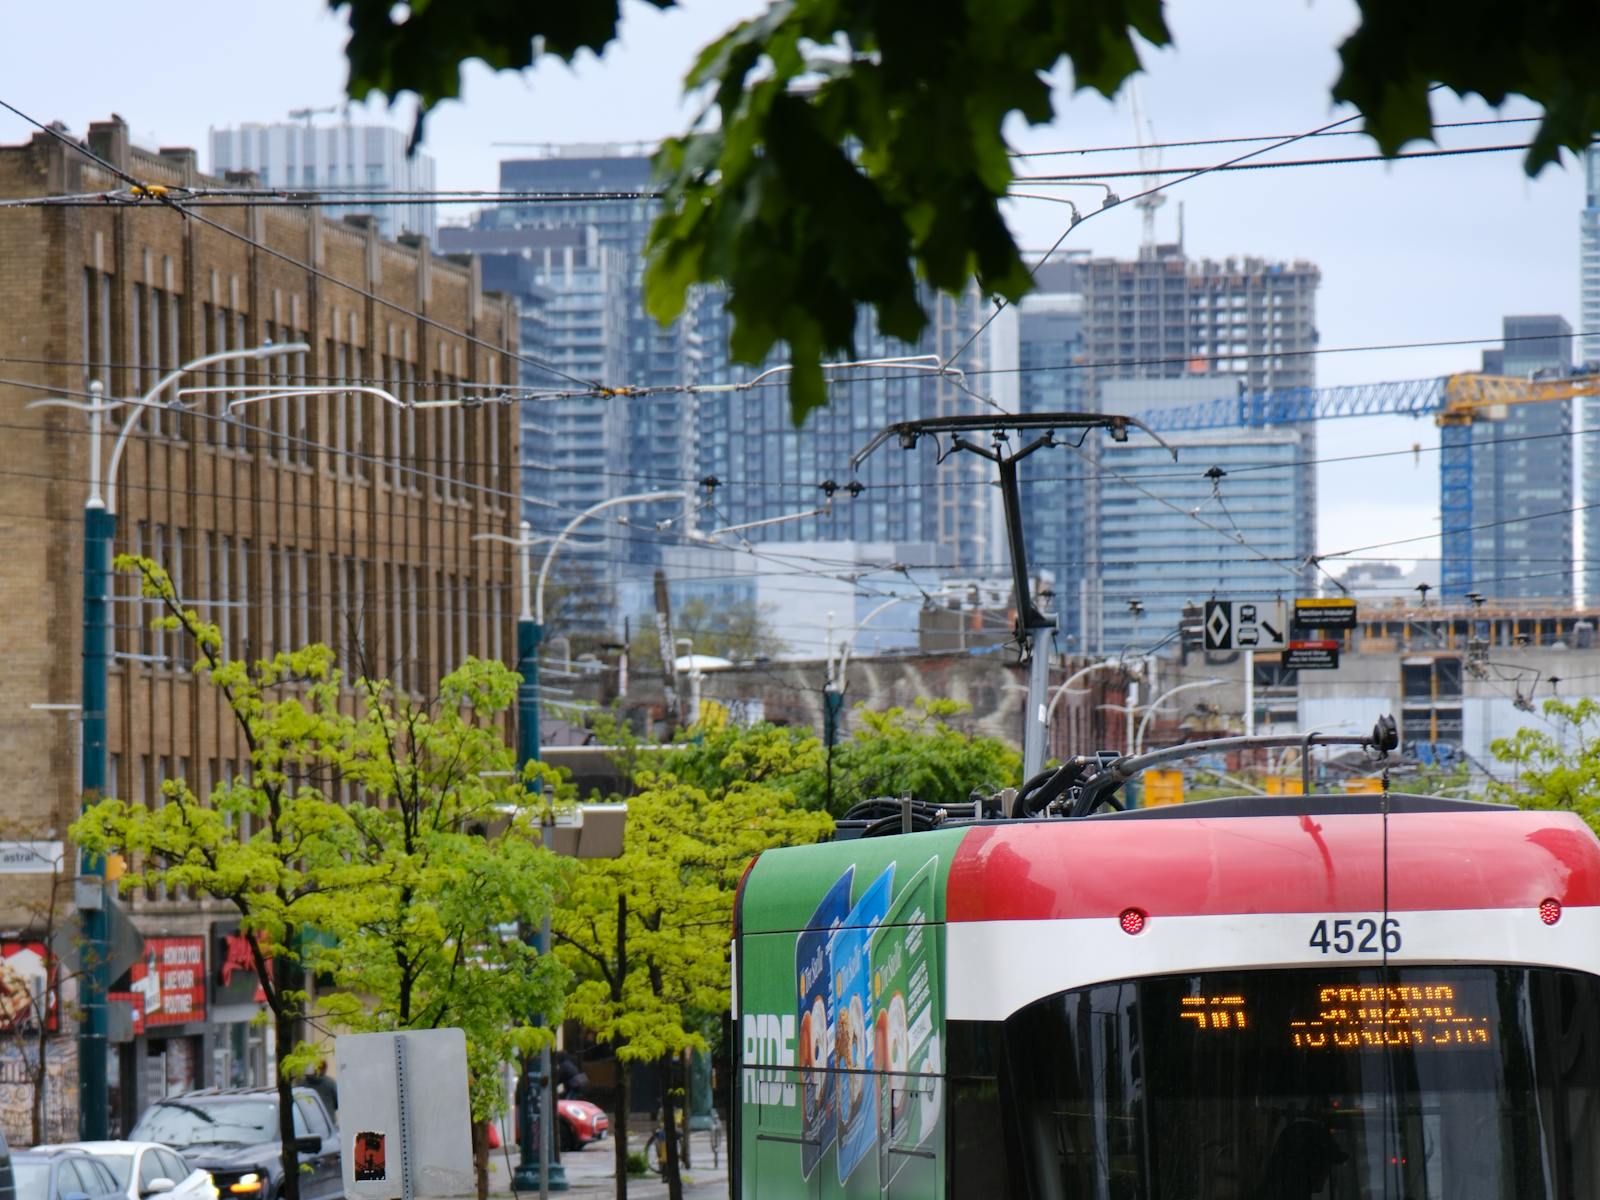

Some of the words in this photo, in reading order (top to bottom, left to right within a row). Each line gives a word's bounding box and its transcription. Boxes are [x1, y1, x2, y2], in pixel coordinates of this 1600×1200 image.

[1297, 609, 1323, 617] Section
[1309, 918, 1402, 954] 4526
[743, 1013, 797, 1107] RIDE
